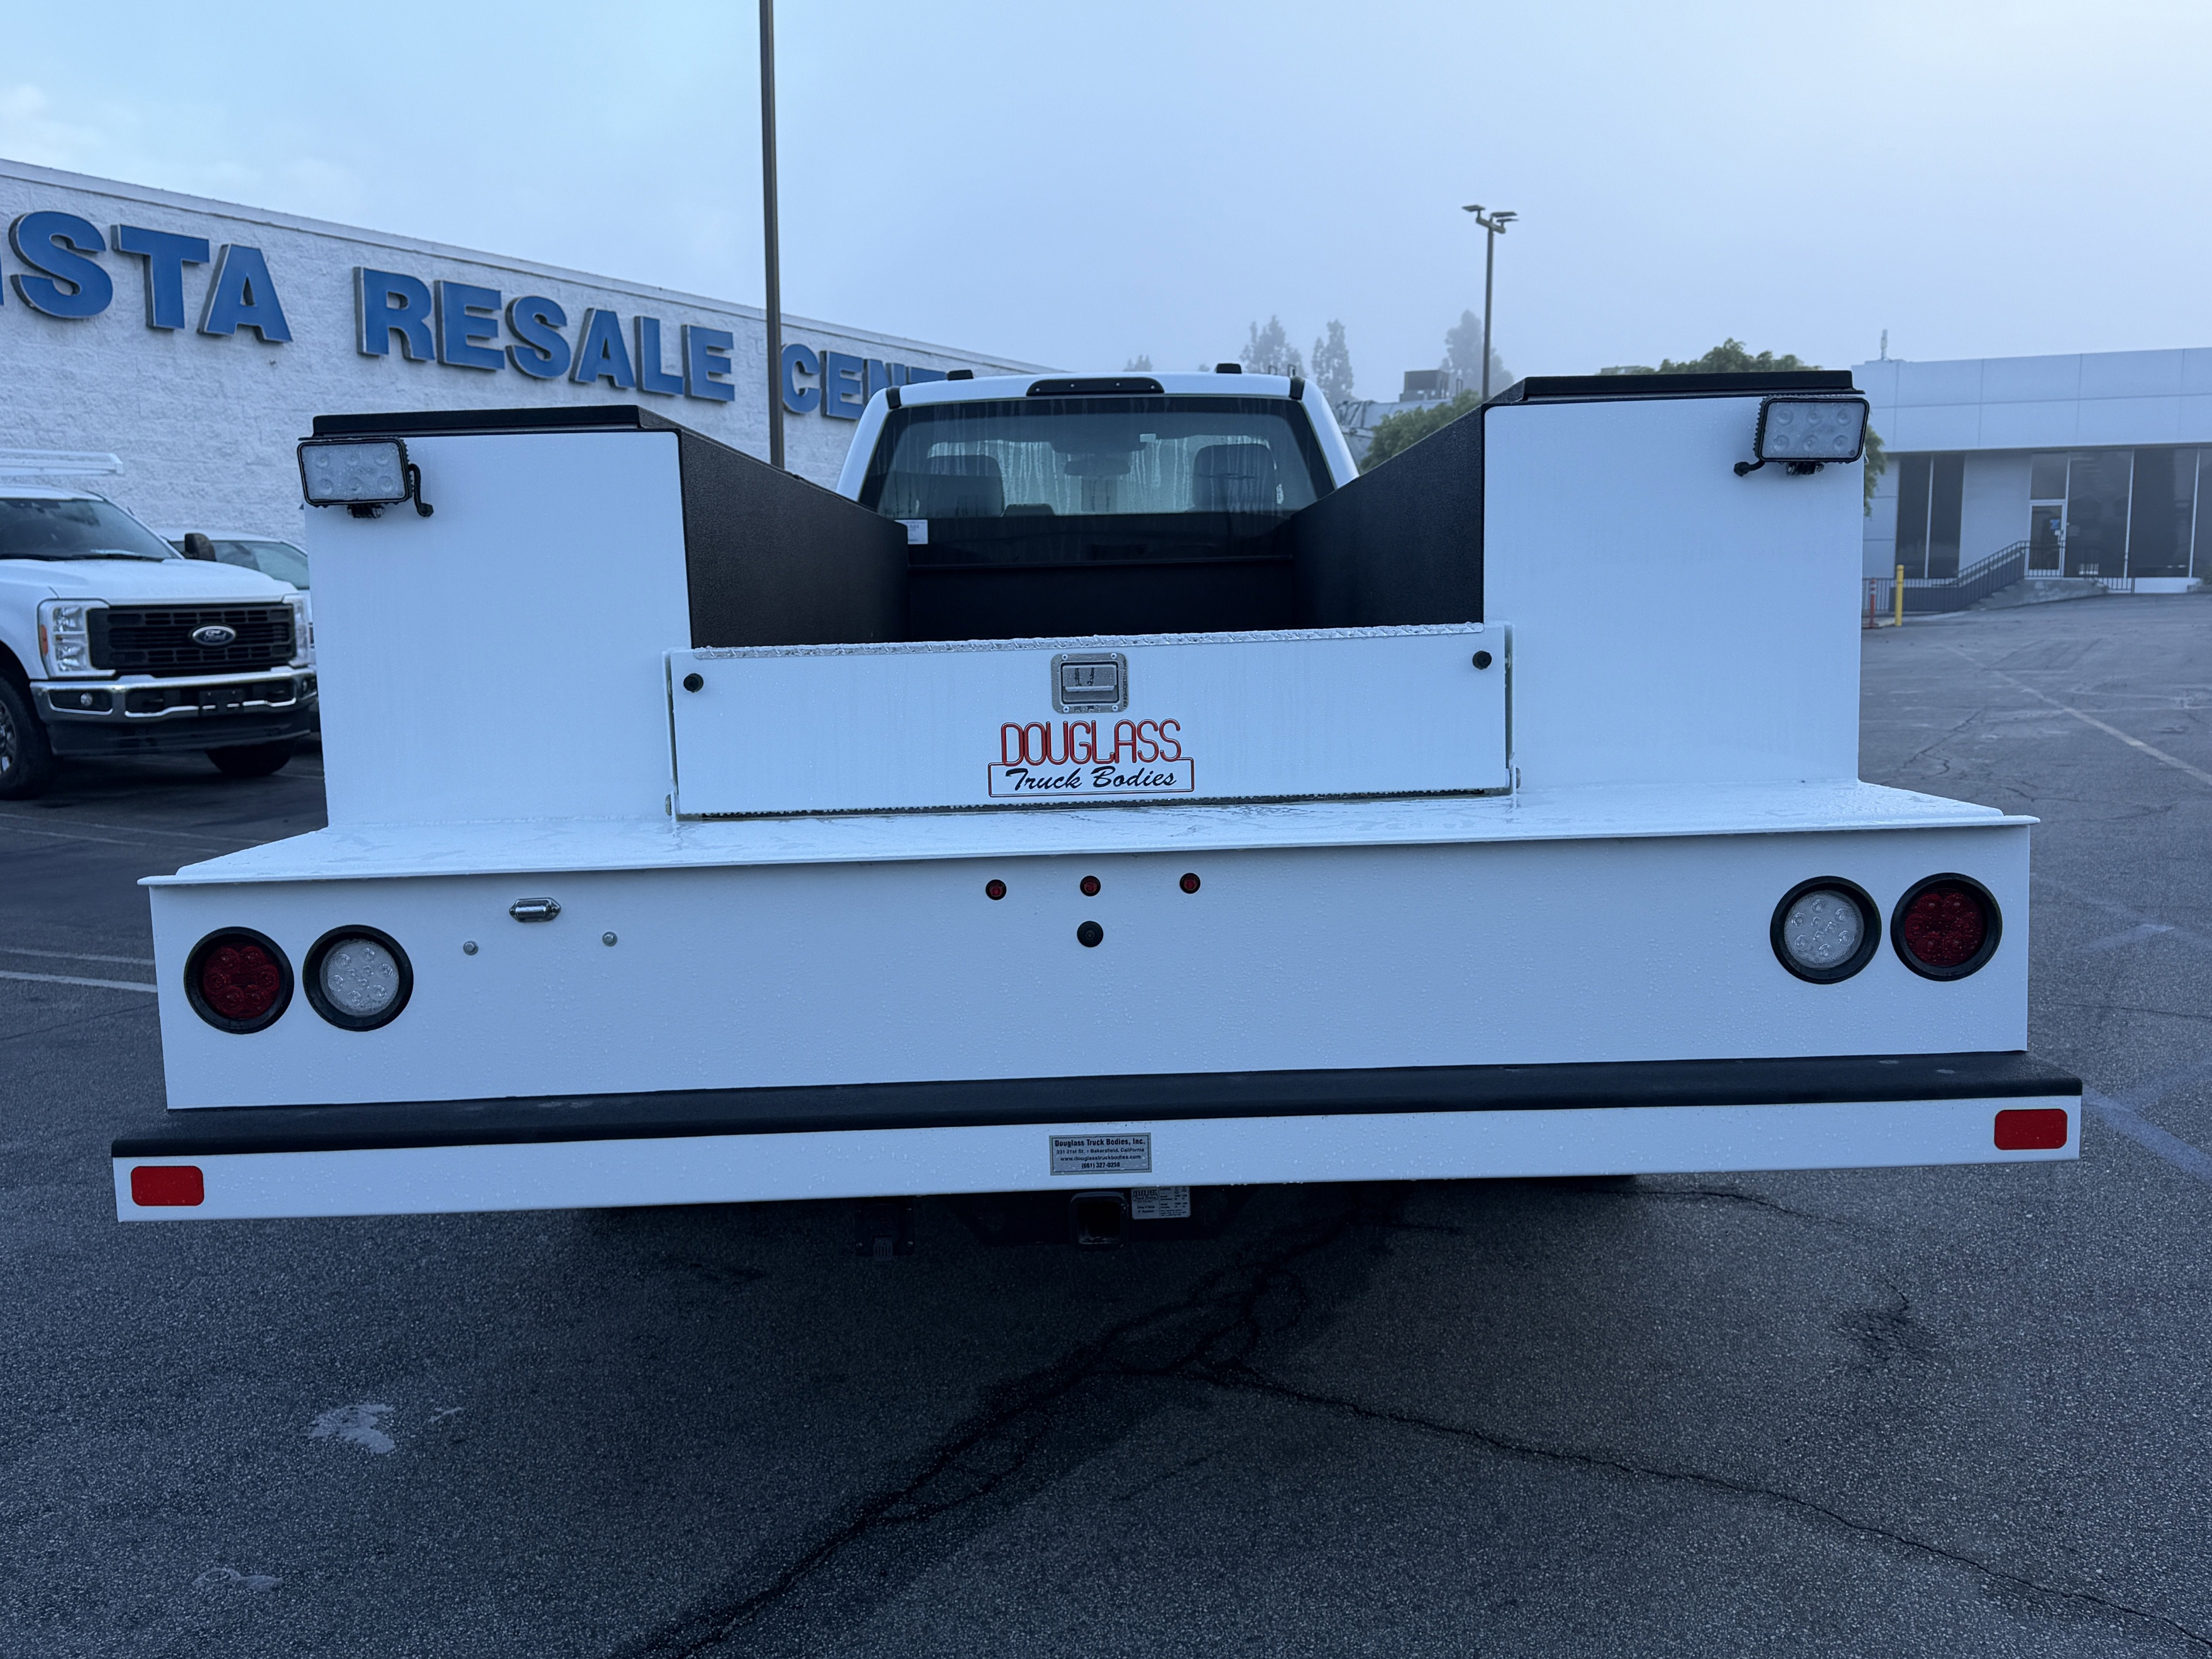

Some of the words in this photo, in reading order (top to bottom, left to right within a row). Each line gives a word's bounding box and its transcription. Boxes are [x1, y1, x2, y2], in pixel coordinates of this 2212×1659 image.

[0, 209, 293, 343] STA
[353, 266, 735, 402] RESALE
[1001, 718, 1182, 766] DOUGLASS
[1005, 767, 1082, 791] Truck
[1091, 766, 1177, 788] Bodies
